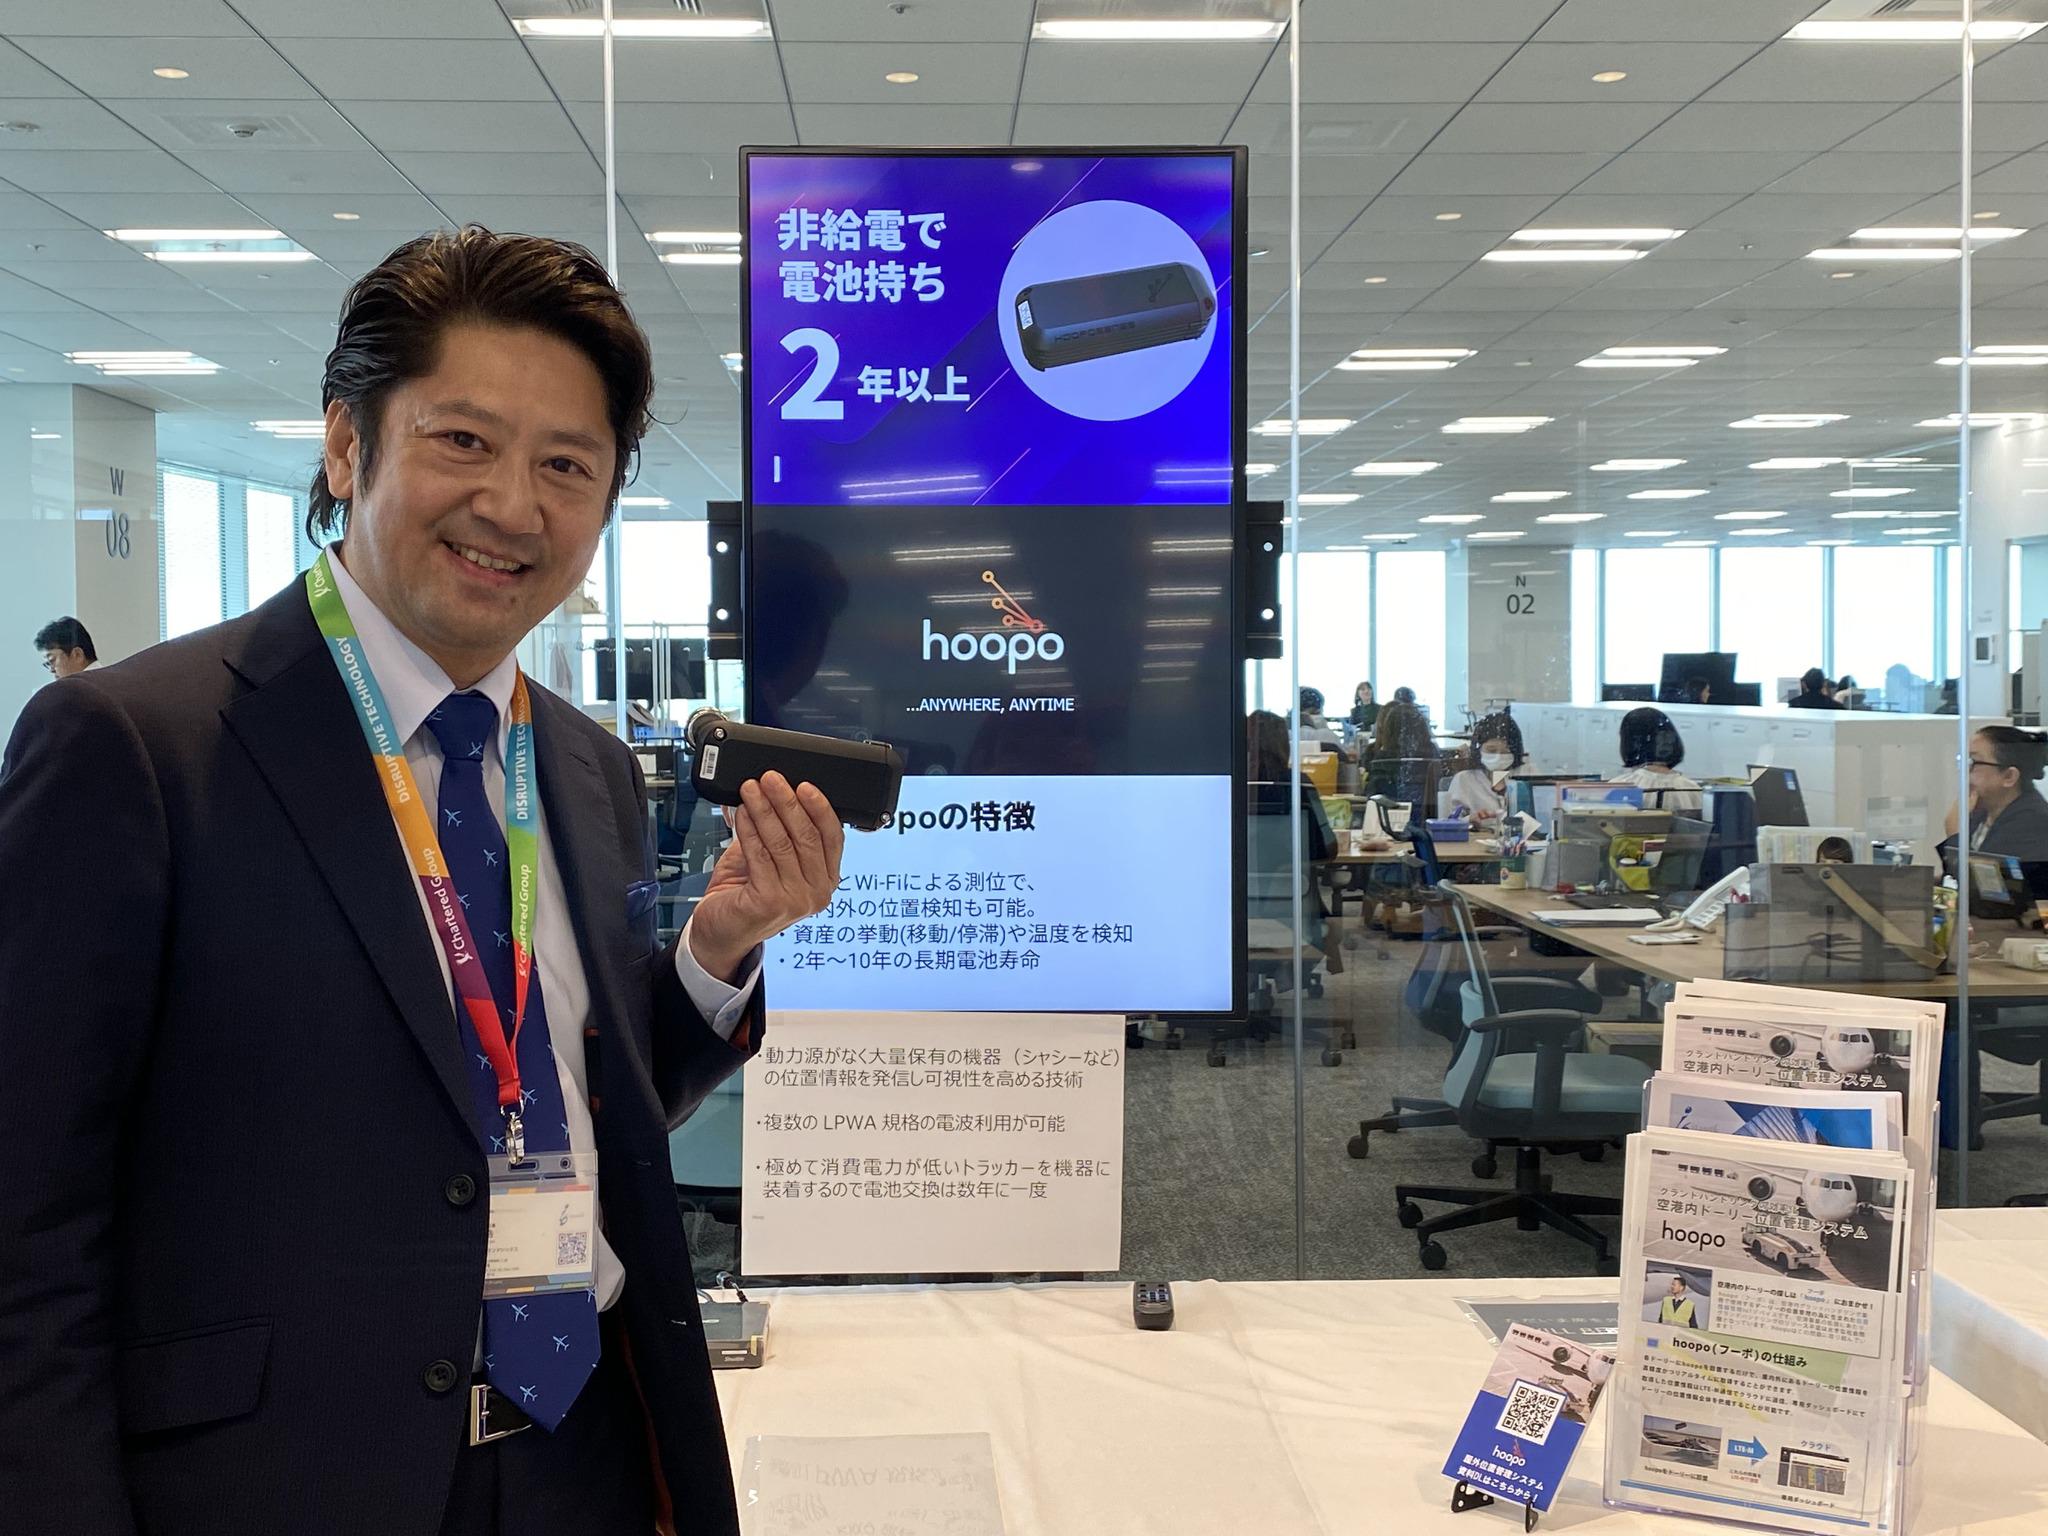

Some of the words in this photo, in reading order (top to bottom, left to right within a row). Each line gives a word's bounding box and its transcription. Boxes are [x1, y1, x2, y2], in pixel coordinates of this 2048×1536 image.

[777, 208, 946, 251] 非給電で
[778, 261, 945, 302] 電池持ち
[779, 328, 844, 420] 2
[857, 366, 970, 403] 年以上
[109, 466, 124, 496] W
[106, 511, 129, 559] 08
[1515, 575, 1526, 587] N
[1506, 593, 1535, 615] 02
[922, 618, 1064, 674] hoopo
[1009, 697, 1075, 711] ANYTIME
[373, 724, 410, 804] DISRUPTIVE
[515, 749, 529, 820] DISRUPTIVE
[424, 848, 443, 888] Group
[519, 864, 532, 901] Group
[434, 889, 465, 950] Chartered
[823, 1115, 877, 1132] LPWA
[881, 1114, 1066, 1134] 規格の電波利用が可能
[763, 1181, 1048, 1201] 装着するので電池交換は数年に一度
[1662, 1220, 1726, 1251] hoopo
[1492, 1445, 1526, 1466] hoopo
